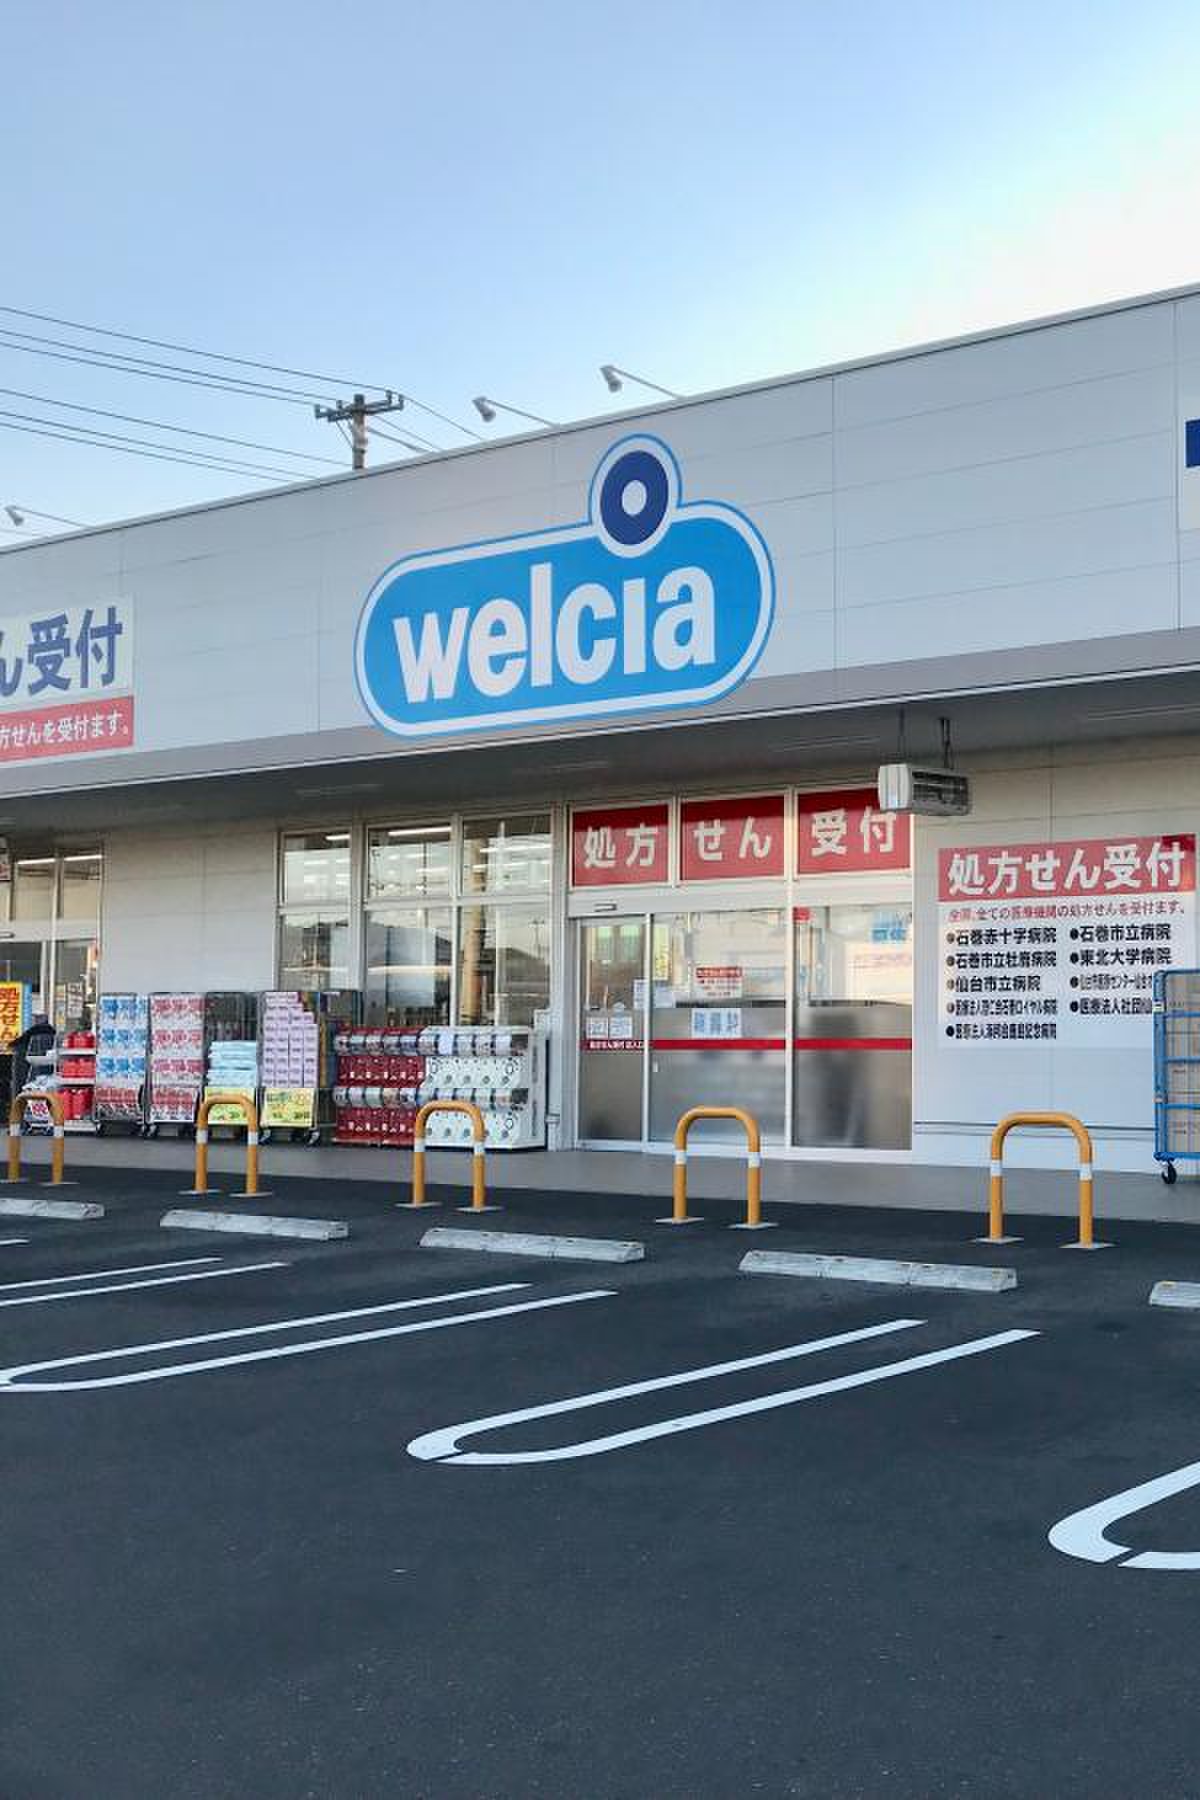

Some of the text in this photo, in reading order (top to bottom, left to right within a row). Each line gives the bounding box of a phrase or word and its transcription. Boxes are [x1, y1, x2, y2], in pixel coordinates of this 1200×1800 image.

[392, 561, 716, 704] welcia
[948, 842, 1186, 896] 処方せん受付
[1080, 923, 1172, 942] 石巻市立病院
[1080, 948, 1172, 966] 東北大学病院
[956, 975, 1041, 993] 仙台市立病院
